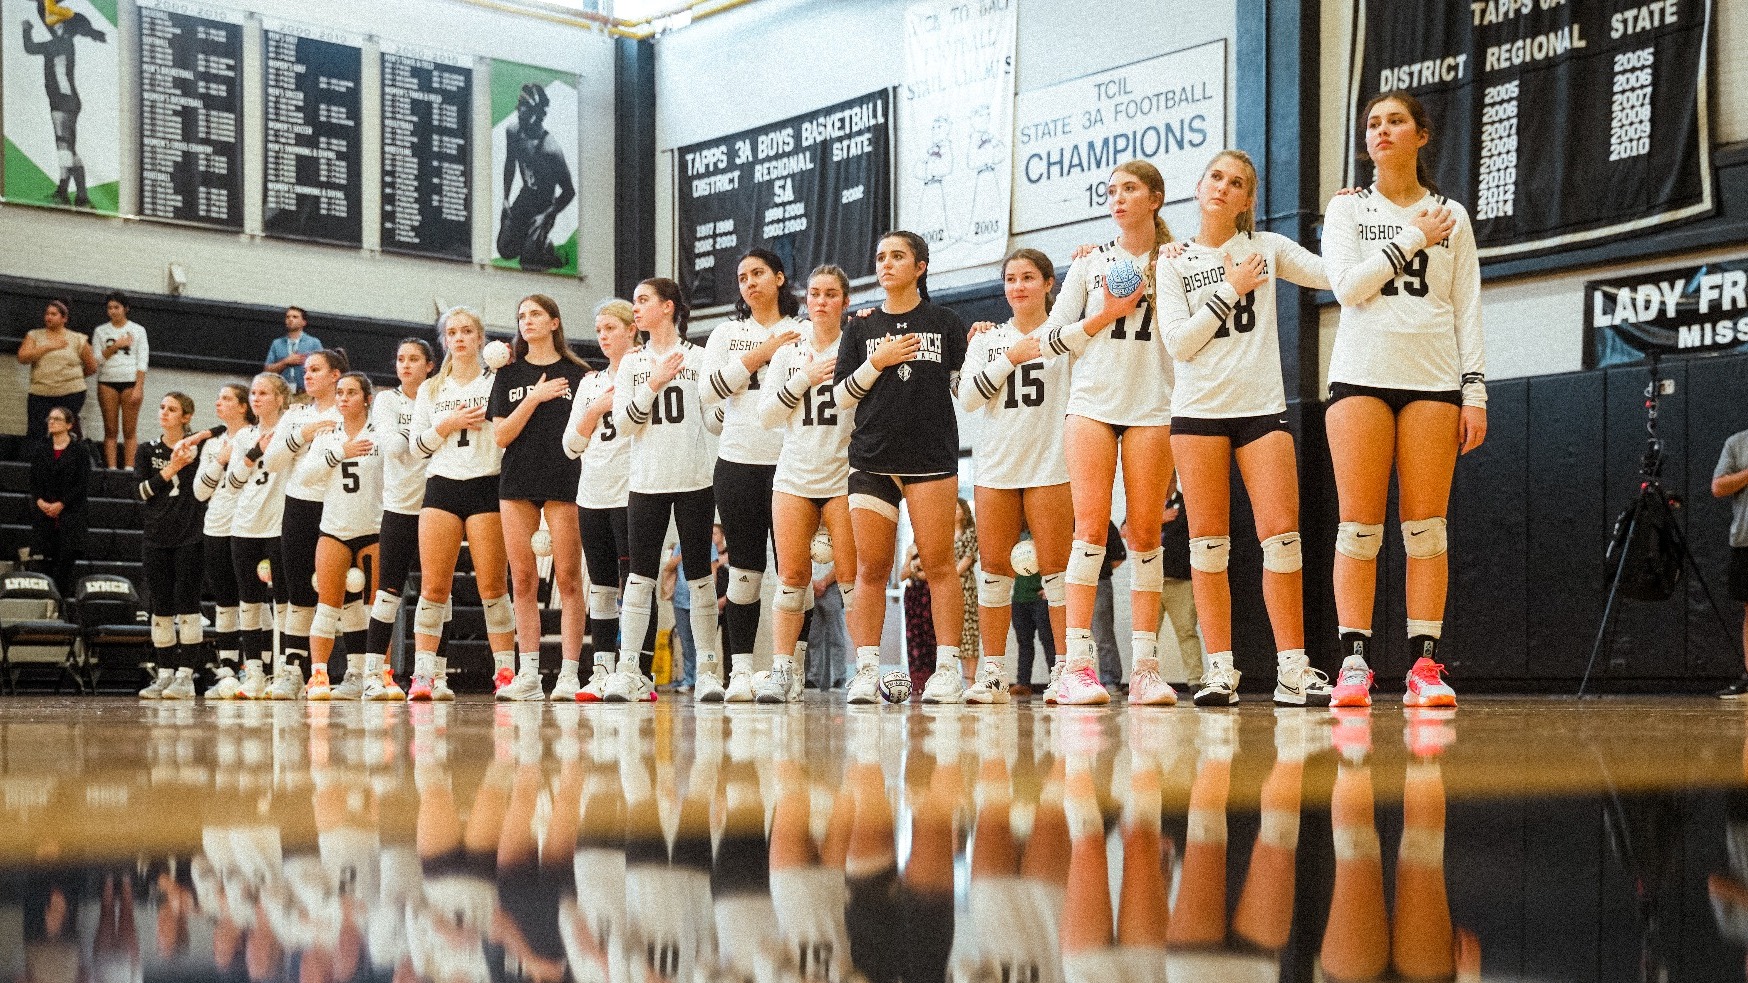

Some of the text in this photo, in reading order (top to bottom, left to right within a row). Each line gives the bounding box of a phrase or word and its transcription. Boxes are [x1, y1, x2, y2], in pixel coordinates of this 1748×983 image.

[1470, 0, 1533, 26] TAPPS
[1610, 0, 1678, 39] STATE
[1379, 23, 1587, 93] DISTRICT REGIONAL
[1614, 47, 1655, 72] 2005
[1094, 77, 1133, 101] TCIL
[1484, 80, 1520, 104] 2005
[1613, 68, 1653, 93] 2006
[1482, 101, 1518, 123] 2006
[1612, 86, 1653, 112] 2007
[1021, 81, 1213, 145] STATE 3A FOOTBALL
[685, 99, 885, 177] TAPPS 3A BOYS BASKETBALL
[1481, 117, 1518, 140] 2007
[1025, 114, 1207, 184] CHAMPIONS
[1609, 137, 1650, 161] 2010
[692, 132, 873, 198] DISTRICT REGIONAL STATE
[773, 177, 795, 204] 5A
[1479, 167, 1516, 190] 2010
[1085, 181, 1108, 208] 19
[1478, 183, 1515, 205] 2012
[1183, 266, 1226, 293] BISHOP
[1593, 270, 1748, 328] LADY FR
[729, 340, 763, 351] BISHO
[1678, 317, 1748, 349] MISS
[509, 386, 524, 403] GO
[1004, 362, 1044, 409] 15
[651, 385, 685, 425] 10
[802, 385, 838, 427] 12
[342, 461, 360, 493] 5
[4, 577, 49, 590] LYNCH
[85, 580, 130, 594] LYNCH
